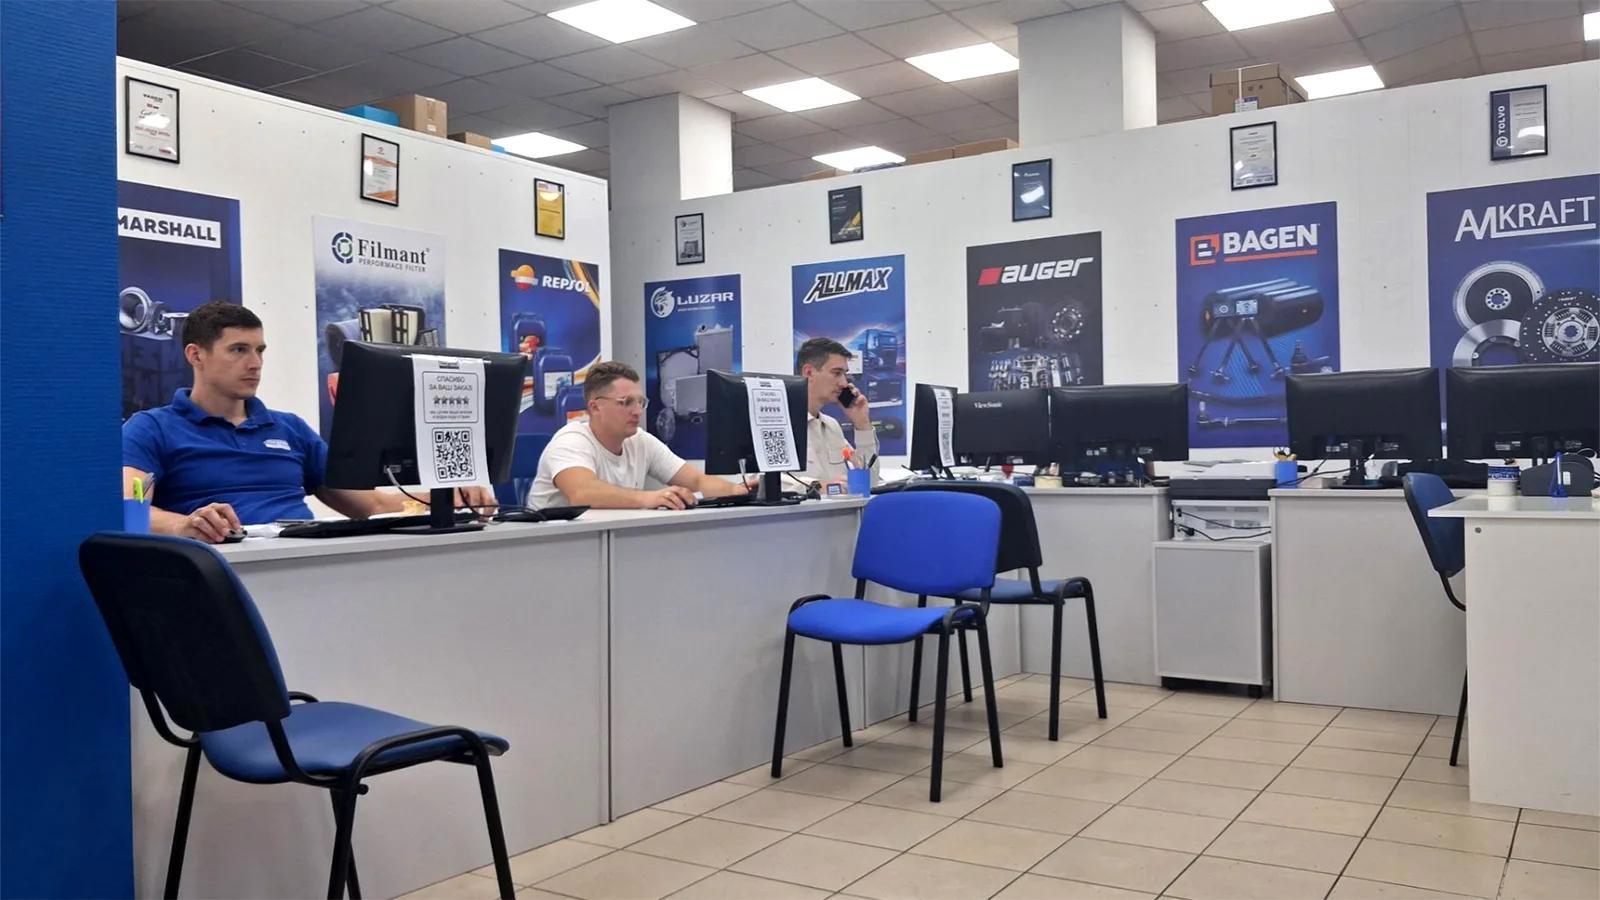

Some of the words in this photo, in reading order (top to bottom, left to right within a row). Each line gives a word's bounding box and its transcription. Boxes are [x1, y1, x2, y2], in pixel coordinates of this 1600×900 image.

[1497, 105, 1506, 135] TOLVO
[357, 238, 427, 265] Filmant
[1223, 223, 1318, 255] BAGEN
[405, 263, 426, 273] FILTER
[541, 275, 592, 293] REPSOL
[803, 266, 893, 304] ALLMAX
[677, 292, 734, 306] LUZAR
